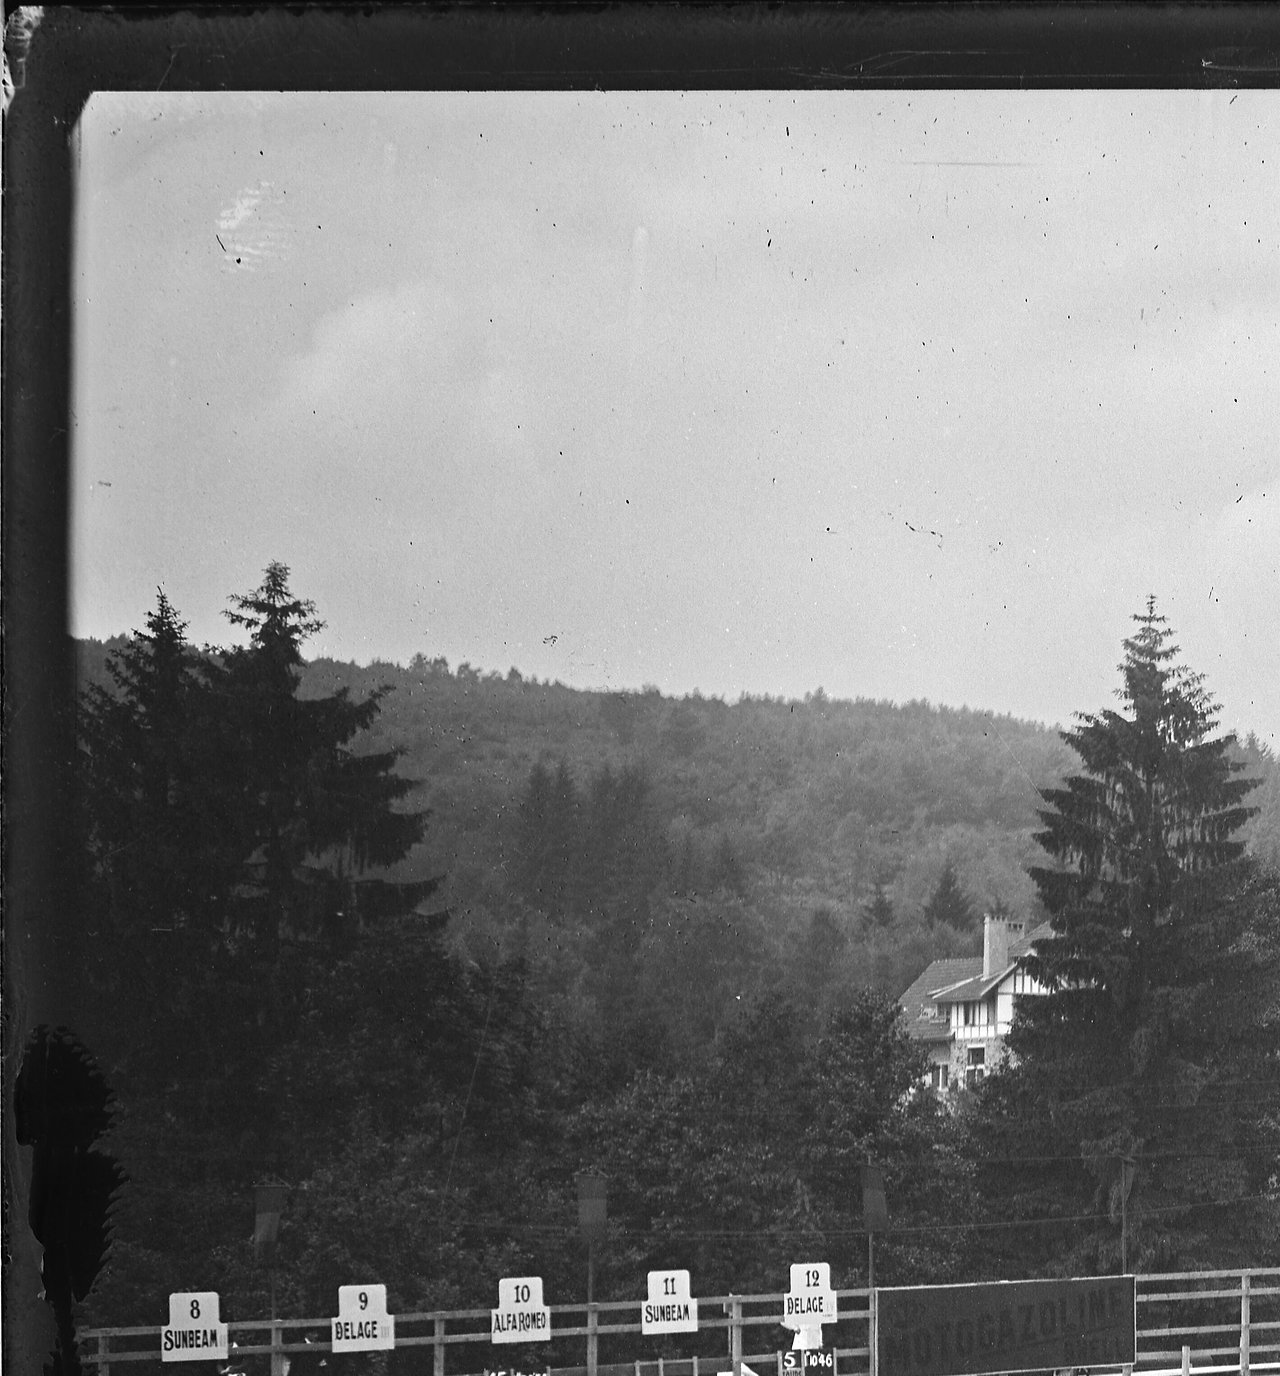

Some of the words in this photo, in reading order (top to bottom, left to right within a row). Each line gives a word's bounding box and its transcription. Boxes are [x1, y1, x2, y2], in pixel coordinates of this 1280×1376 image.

[663, 1277, 676, 1295] 11
[806, 1270, 819, 1287] 12
[359, 1292, 369, 1310] 9
[514, 1285, 530, 1303] 10
[190, 1299, 201, 1319] 8
[645, 1305, 690, 1323] SUNBEAM
[787, 1296, 824, 1315] DELAGE
[335, 1320, 378, 1340] DELAGE
[493, 1313, 518, 1333] ALFA
[518, 1311, 546, 1332] ROMEO
[163, 1328, 218, 1352] SUNBEAM
[784, 1351, 796, 1368] 5
